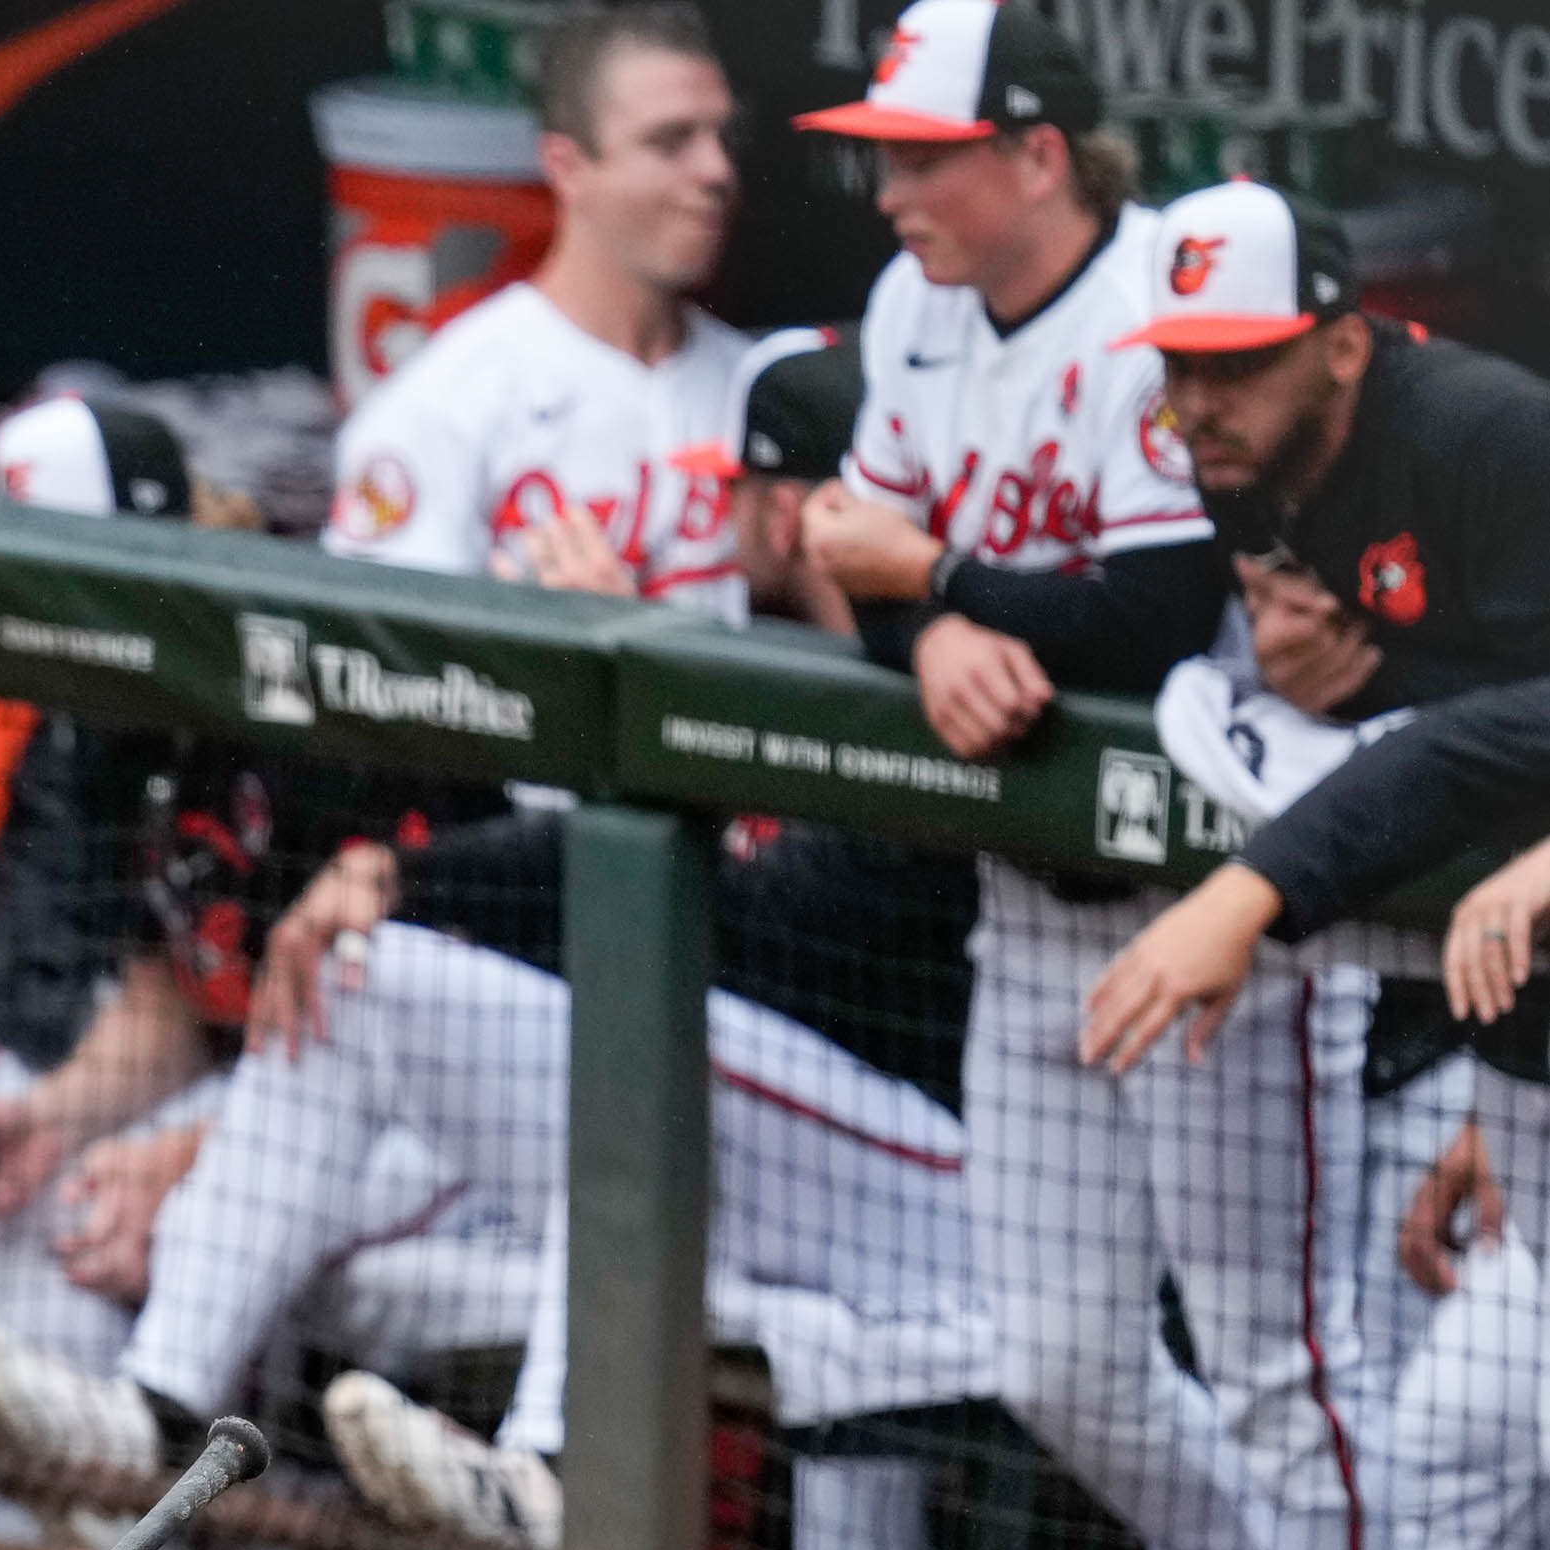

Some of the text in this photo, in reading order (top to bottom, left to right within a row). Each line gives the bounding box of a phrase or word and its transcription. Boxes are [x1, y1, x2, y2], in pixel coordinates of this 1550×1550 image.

[661, 714, 1001, 803] INVEST WITH CONFIDENCE
